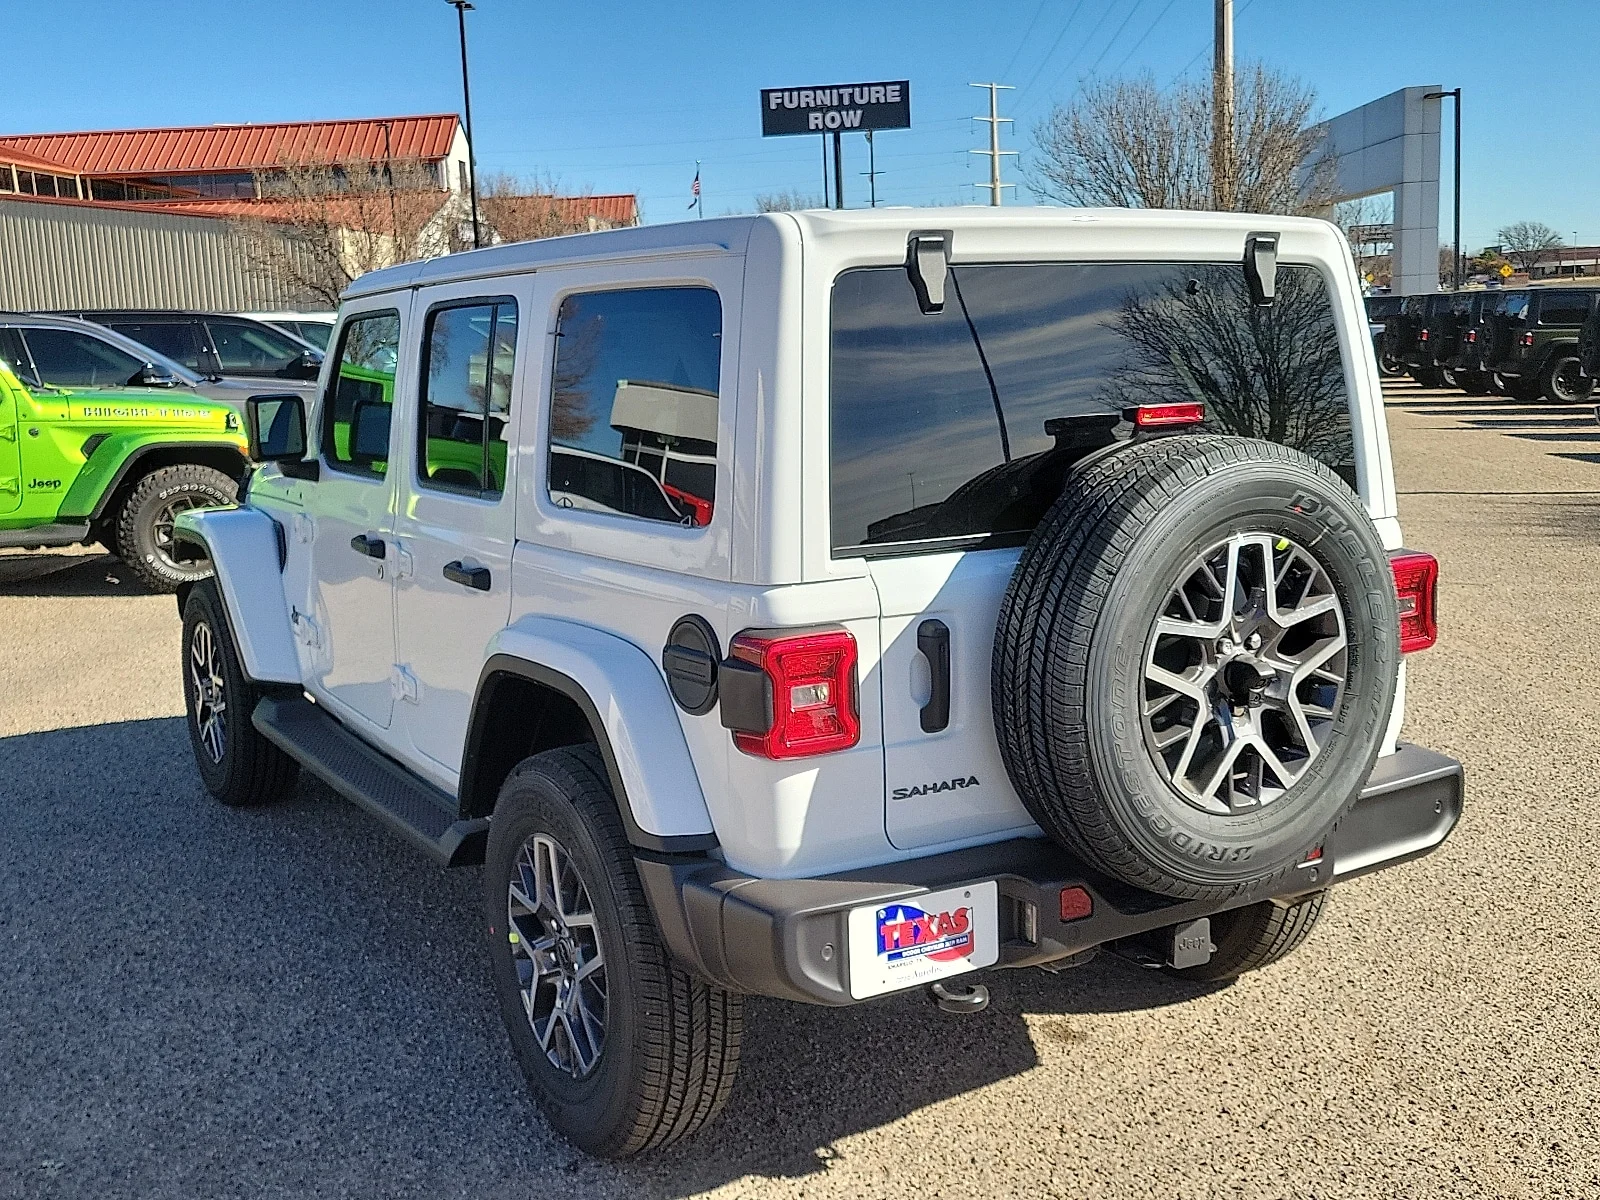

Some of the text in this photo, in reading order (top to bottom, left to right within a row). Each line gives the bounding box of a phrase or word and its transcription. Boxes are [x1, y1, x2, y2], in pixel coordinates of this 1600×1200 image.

[768, 84, 902, 110] FURNITURE
[808, 109, 864, 130] ROW
[28, 478, 62, 489] Jeep
[1285, 489, 1388, 664] DUELER
[1111, 645, 1255, 864] BRIDGESTONE
[892, 775, 980, 800] SAHARA
[881, 907, 969, 950] TEXAS
[956, 936, 968, 945] RAM
